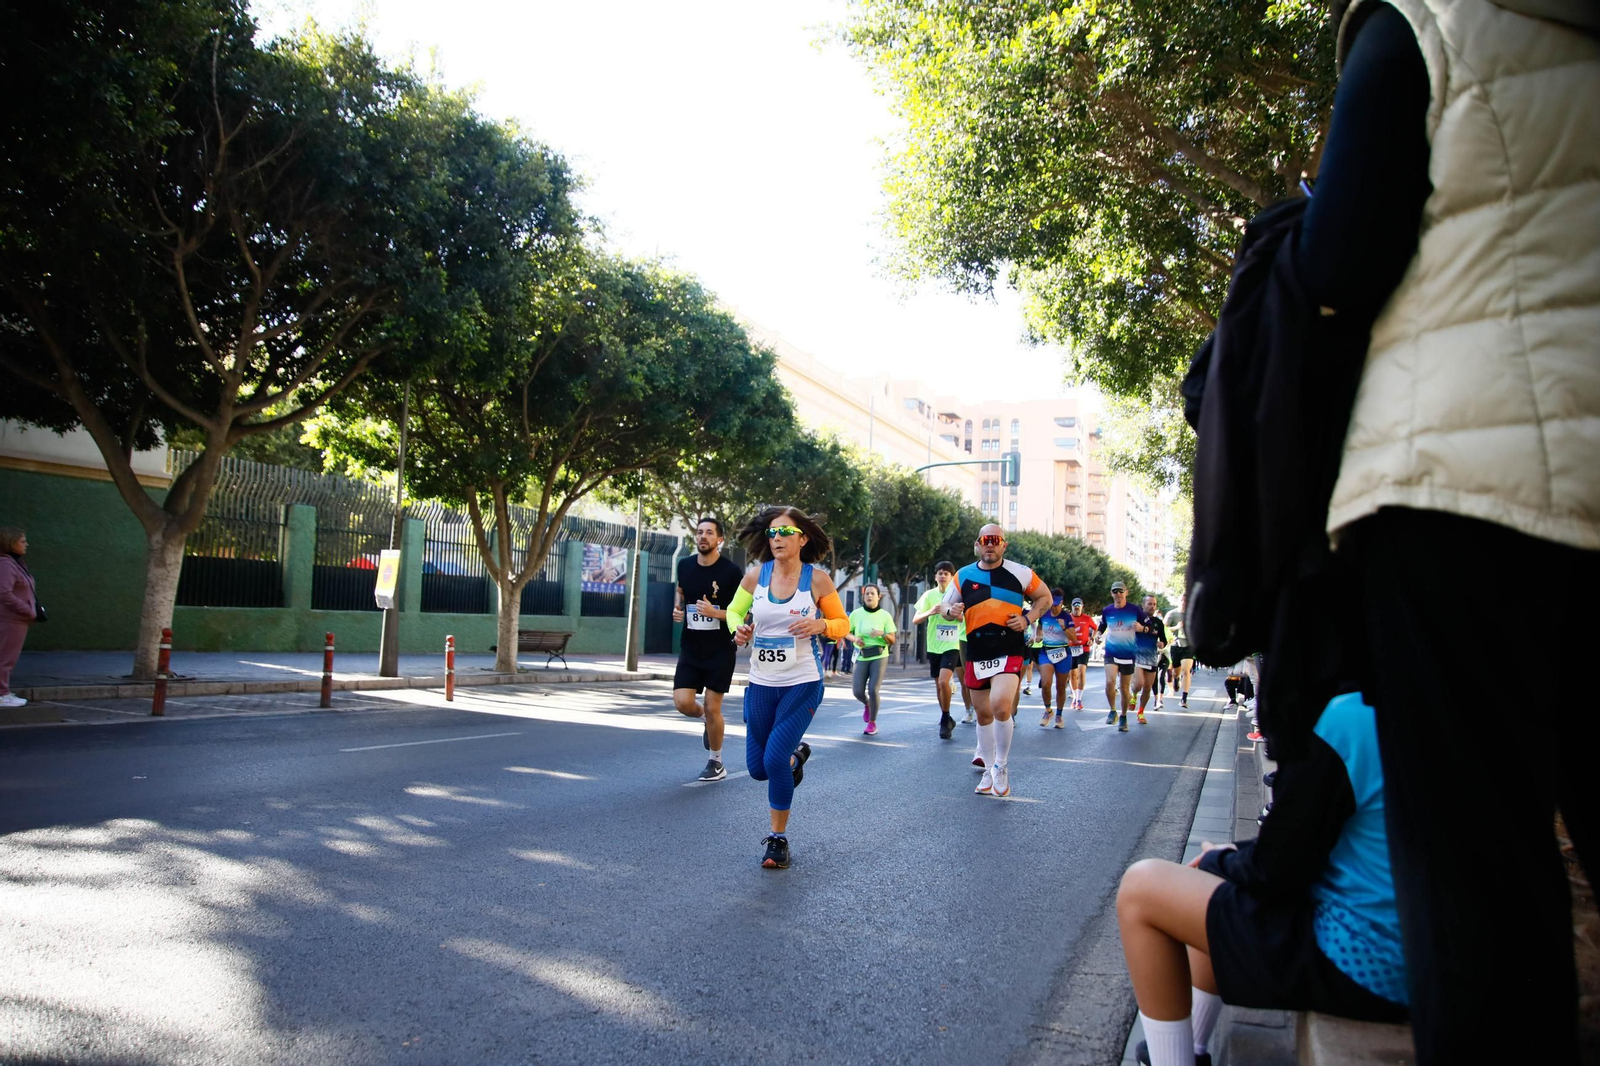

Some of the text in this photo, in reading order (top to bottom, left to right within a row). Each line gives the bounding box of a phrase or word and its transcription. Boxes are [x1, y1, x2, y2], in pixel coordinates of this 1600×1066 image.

[940, 629, 954, 637] 711
[758, 649, 787, 662] 835
[979, 659, 1000, 671] 309
